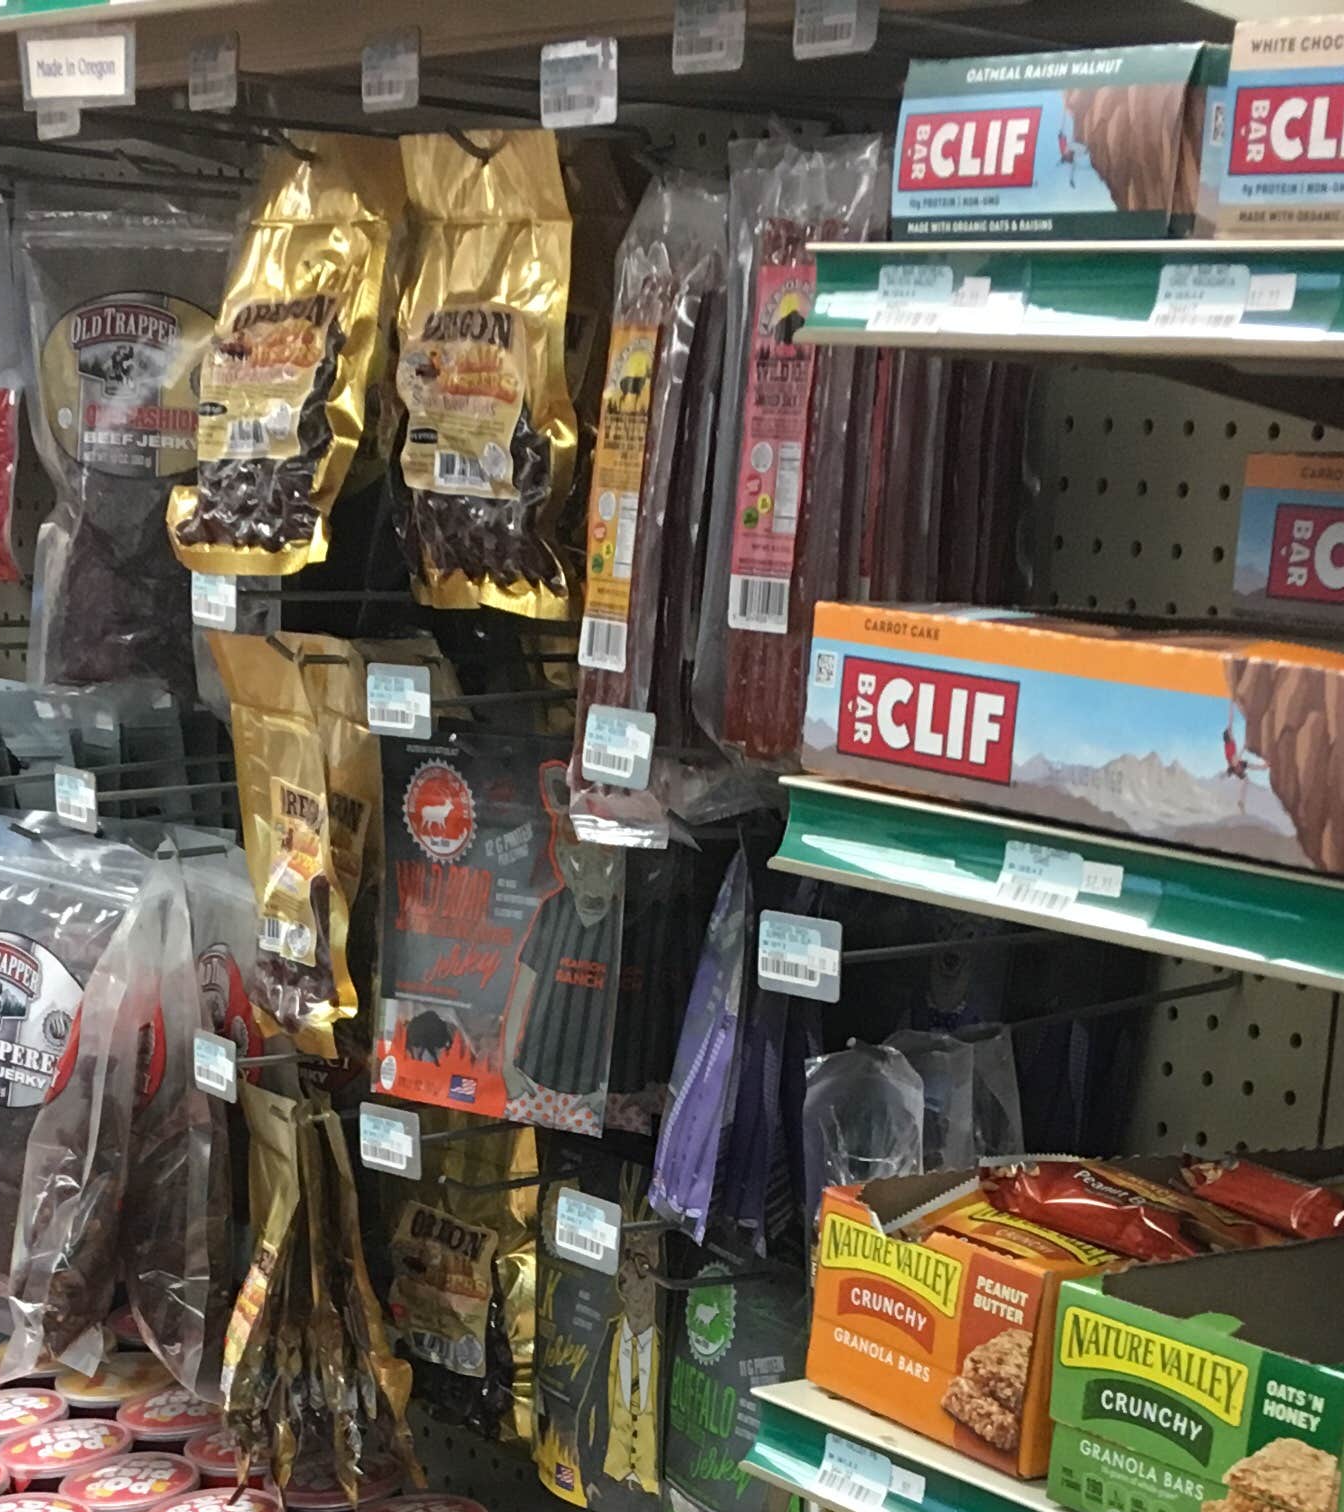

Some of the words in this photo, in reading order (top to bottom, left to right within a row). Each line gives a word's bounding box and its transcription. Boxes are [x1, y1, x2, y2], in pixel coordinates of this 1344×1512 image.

[1251, 36, 1296, 54] WHITE
[36, 59, 63, 78] Made
[66, 58, 76, 76] in
[78, 58, 116, 80] Oregon
[966, 65, 1022, 83] OATMEAL
[1024, 62, 1067, 79] RAISIN
[1071, 58, 1123, 76] WALNUT
[1246, 99, 1271, 163] BAR
[910, 124, 932, 180] BAR
[929, 118, 1031, 180] CLIF
[71, 314, 102, 343] OLD
[83, 432, 133, 447] BEEF
[1287, 518, 1315, 587] BAR
[864, 617, 908, 639] CARROT
[910, 624, 941, 641] CAKE
[853, 673, 877, 745] BAR
[876, 677, 1006, 765] CLIF
[1073, 1169, 1127, 1200] Peanut
[825, 1217, 890, 1271] NATURE
[890, 1241, 958, 1308] VALLEY
[976, 1275, 1030, 1308] PEANUT
[851, 1287, 927, 1333] CRUNCHY
[973, 1294, 1024, 1325] BUTTER
[833, 1327, 895, 1369] GRANOLA
[897, 1354, 931, 1383] BARS
[1068, 1312, 1154, 1367] NATURE
[1152, 1341, 1246, 1417] VALLEY
[1265, 1380, 1306, 1410] OATS
[1100, 1390, 1203, 1443] CRUNCHY
[1262, 1400, 1321, 1433] HONEY
[1080, 1440, 1157, 1481] GRANOLA
[1163, 1471, 1205, 1501] BARS
